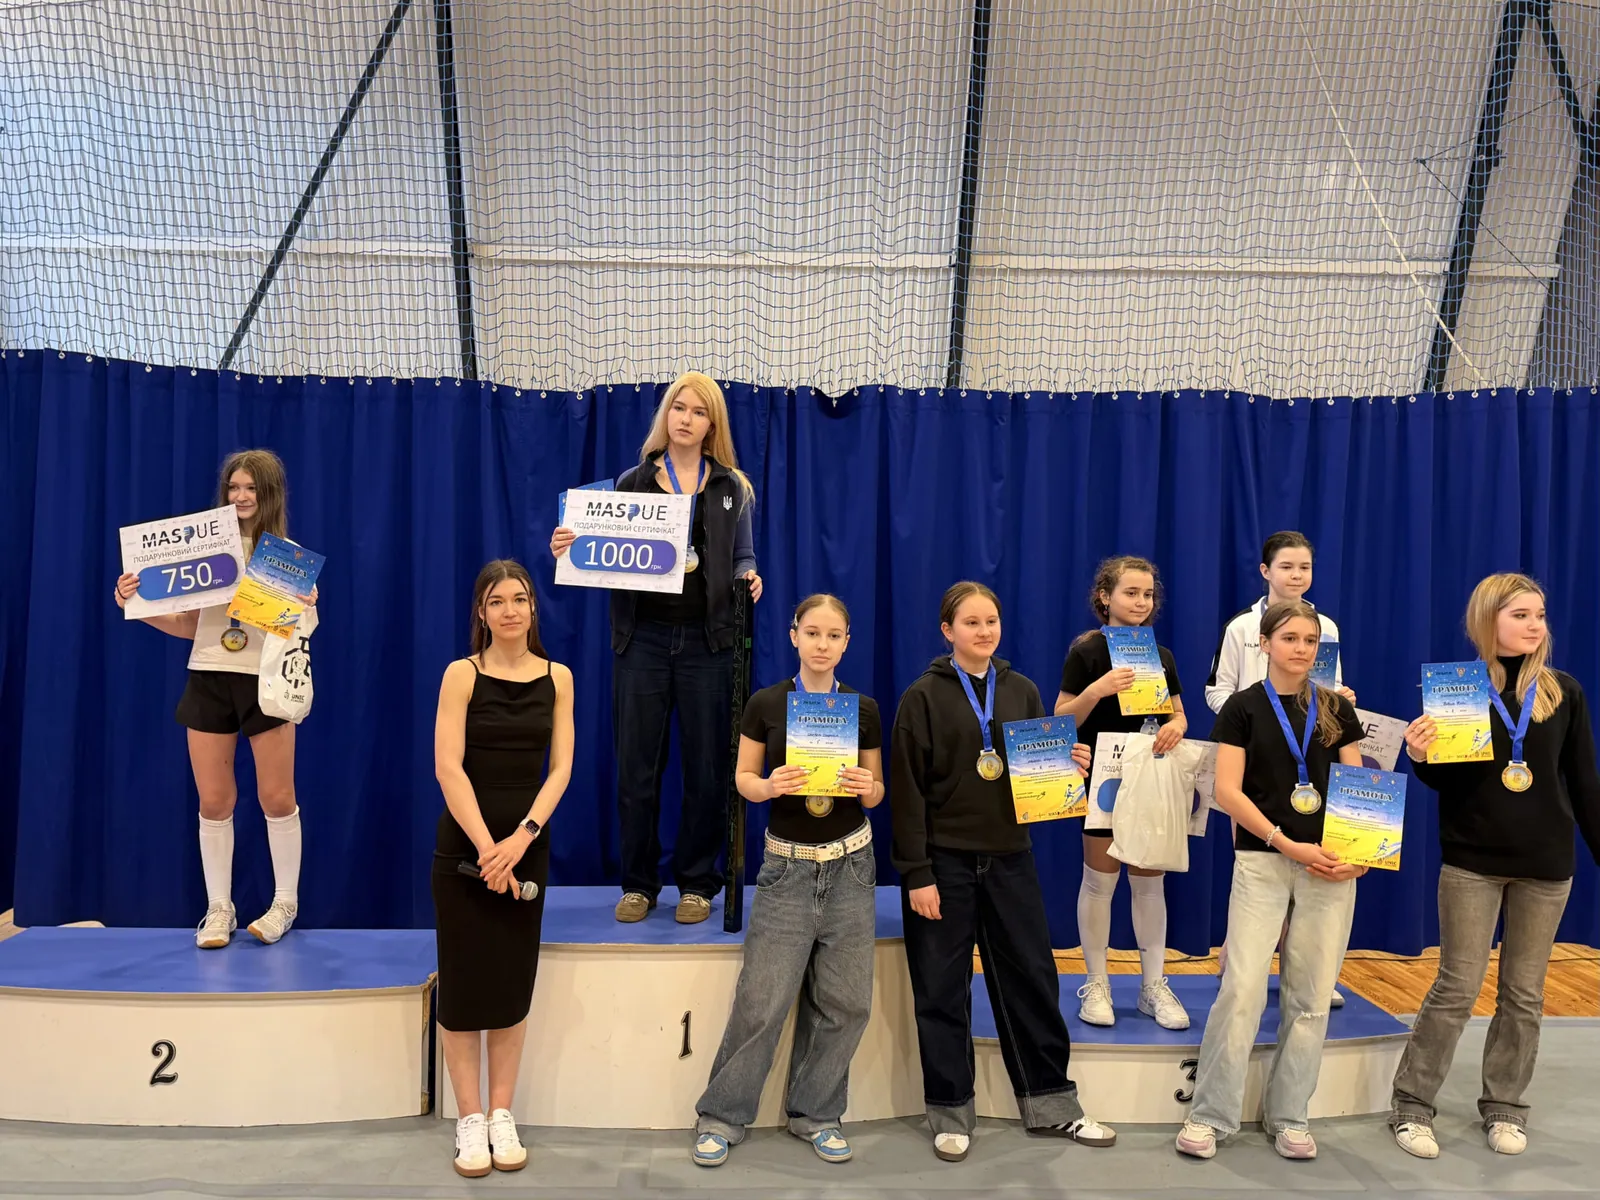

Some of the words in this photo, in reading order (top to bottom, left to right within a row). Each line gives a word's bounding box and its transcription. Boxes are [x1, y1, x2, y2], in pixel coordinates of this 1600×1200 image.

[574, 521, 632, 533] ПОДАРУНКОВИЙ
[633, 526, 676, 535] СЕРТИФІКАТ
[133, 546, 192, 564] ПОДАРУНКОВИЙ
[193, 538, 230, 553] СЕРТИФІКАТ
[584, 540, 653, 570] 1000
[161, 562, 213, 593] 750
[1432, 684, 1478, 694] ГРАМОТА
[798, 715, 848, 725] ГРАМОТА
[1016, 738, 1068, 753] ГРАМОТА
[1339, 786, 1393, 802] ГРАМОТА
[678, 1010, 692, 1060] 1
[149, 1039, 178, 1087] 2
